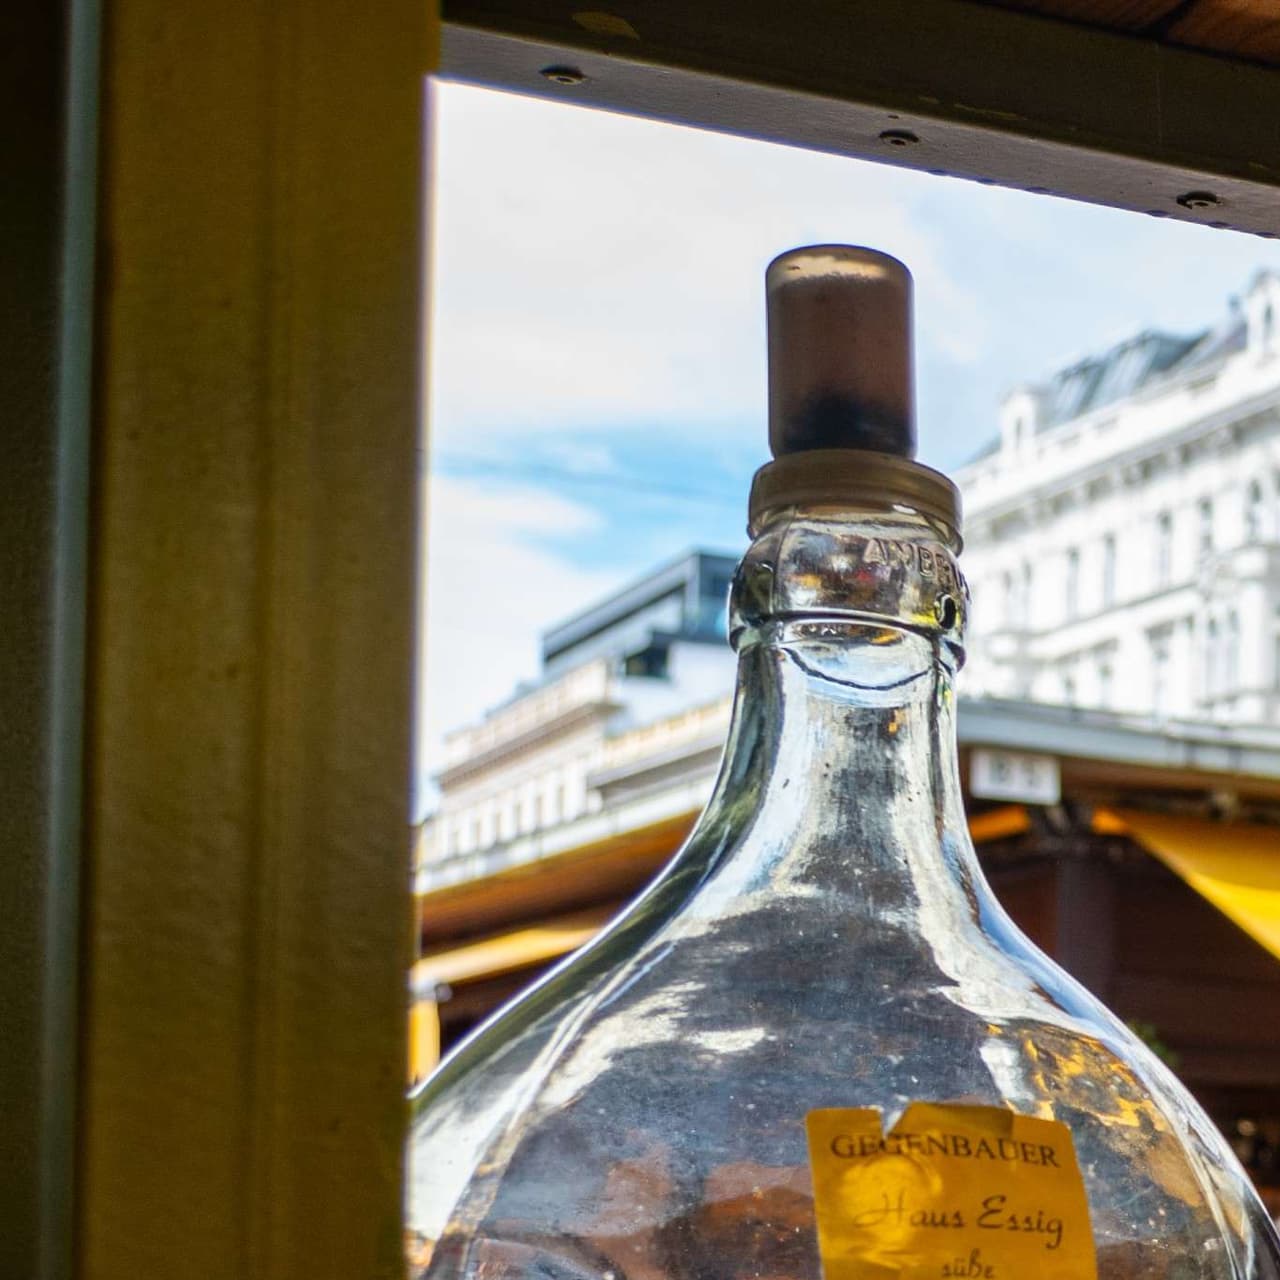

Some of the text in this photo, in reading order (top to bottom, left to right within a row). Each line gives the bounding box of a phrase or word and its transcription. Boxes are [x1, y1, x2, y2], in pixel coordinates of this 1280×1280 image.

[830, 1131, 1062, 1169] GEGENBAUER
[854, 1190, 1064, 1250] Haus Essig
[941, 1248, 995, 1280] süße
